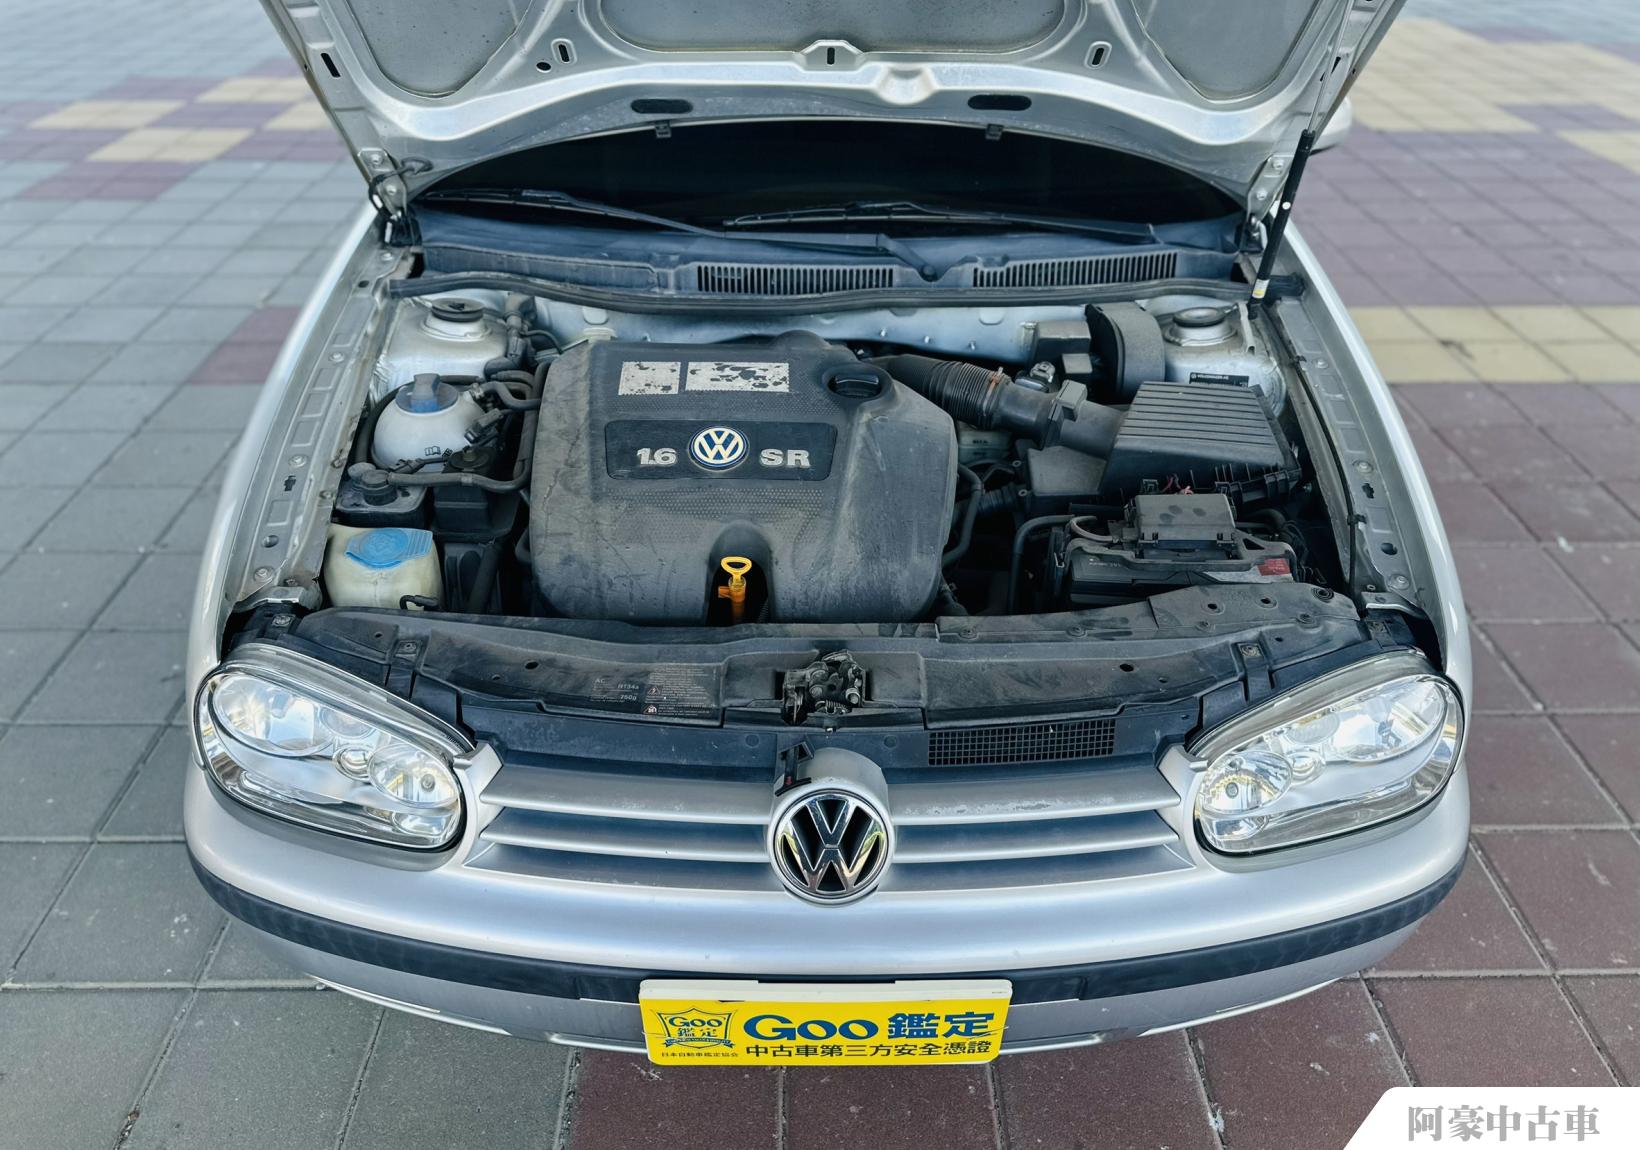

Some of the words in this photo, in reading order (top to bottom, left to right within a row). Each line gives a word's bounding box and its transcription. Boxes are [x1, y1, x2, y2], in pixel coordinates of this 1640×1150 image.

[690, 426, 746, 467] VW
[760, 448, 810, 467] SR
[776, 792, 887, 897] VW
[668, 1016, 723, 1028] Goo
[743, 1014, 879, 1041] Goo
[887, 1011, 995, 1039] 鑑定
[746, 1041, 992, 1058] 中古車第三方安全憑證
